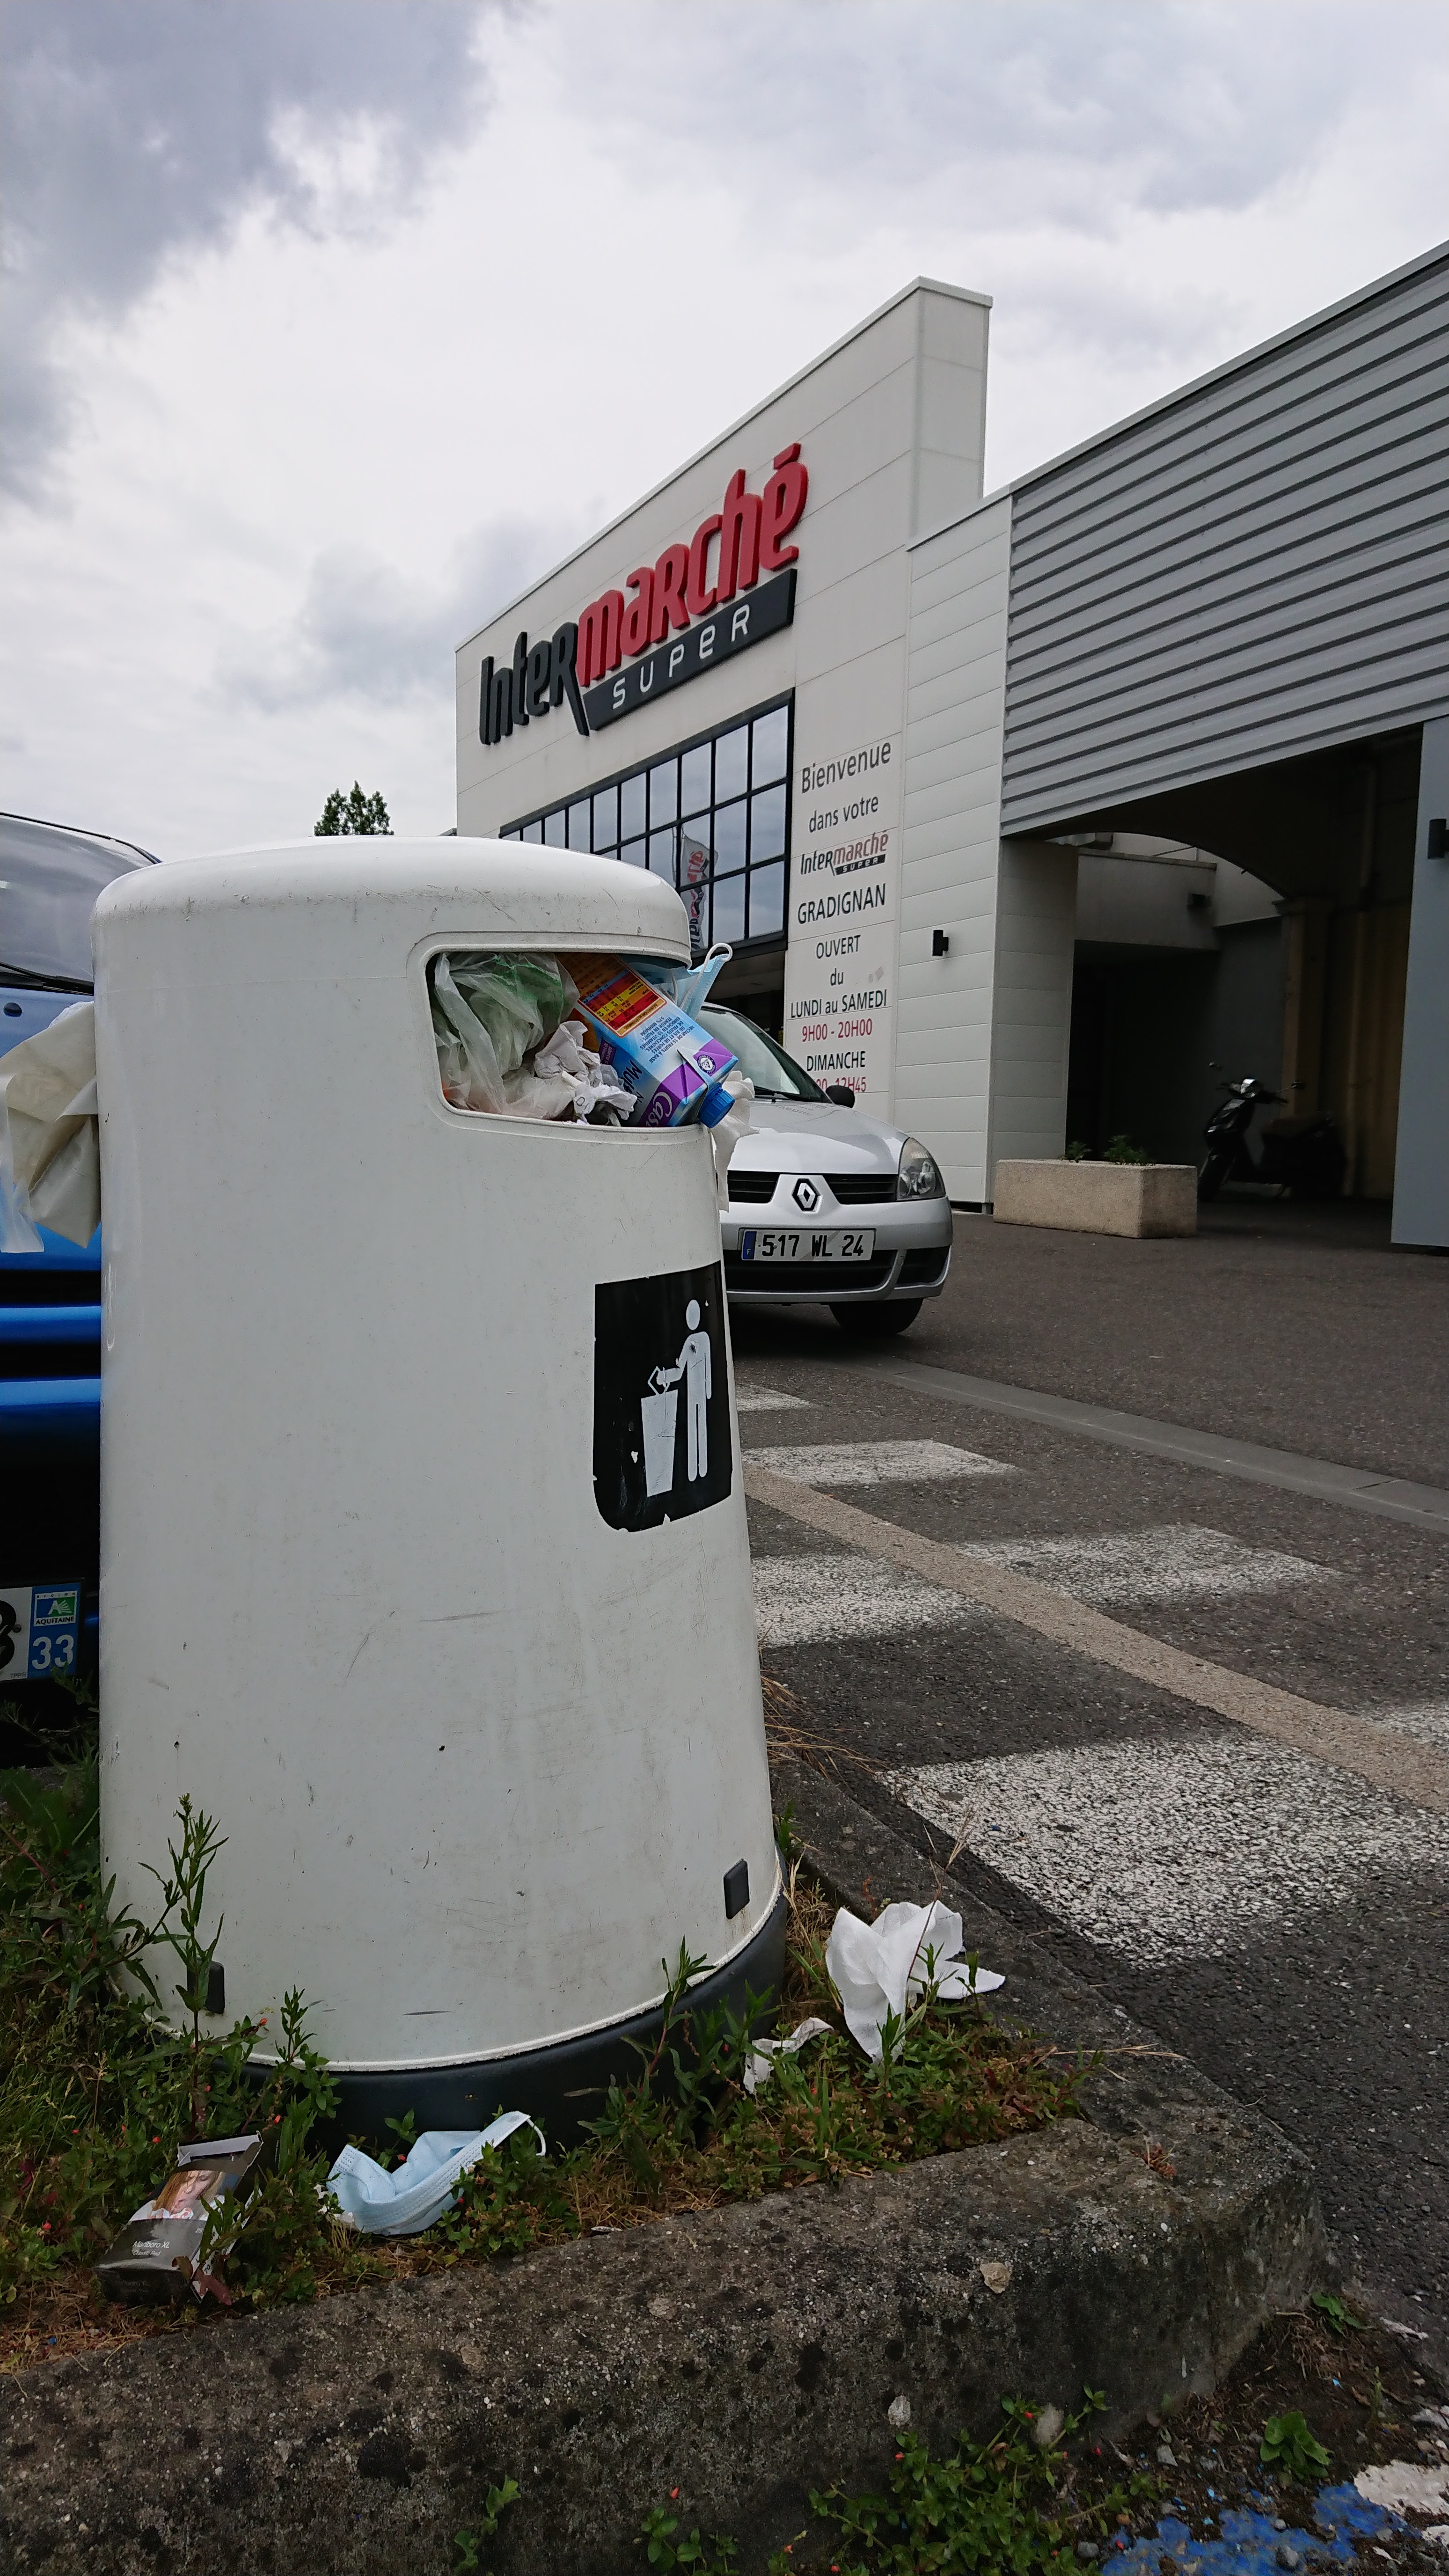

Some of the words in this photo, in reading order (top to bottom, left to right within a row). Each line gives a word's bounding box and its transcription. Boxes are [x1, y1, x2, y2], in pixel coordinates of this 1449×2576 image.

[801, 742, 891, 793] Bienvenue
[809, 810, 839, 833] dans
[842, 796, 878, 822] votre
[798, 883, 886, 924] GRADIGNAN
[816, 935, 861, 959] OUVERT
[830, 968, 844, 986] du
[791, 999, 822, 1018] LUNDI
[825, 1001, 838, 1014] au
[842, 989, 887, 1012] SAMEDI
[640, 1022, 657, 1036] MINIMUM
[659, 1017, 672, 1029] TENEUR
[666, 1025, 679, 1035] FRUITS
[681, 1025, 695, 1037] NECTAR
[802, 1024, 827, 1042] 9H00
[838, 1018, 872, 1039] 20H00
[639, 1034, 659, 1050] VITAMINES
[642, 1030, 655, 1041] FRUITS
[661, 1042, 673, 1053] FRUITS
[648, 1054, 659, 1064] BASE
[806, 1051, 865, 1071] DIMANCHE
[762, 1234, 799, 1257] 517
[812, 1235, 833, 1257] WL
[842, 1235, 864, 1257] 24
[36, 1616, 74, 1625] AQUITAINE
[31, 1634, 74, 1669] 33
[204, 2264, 211, 2274] 70
